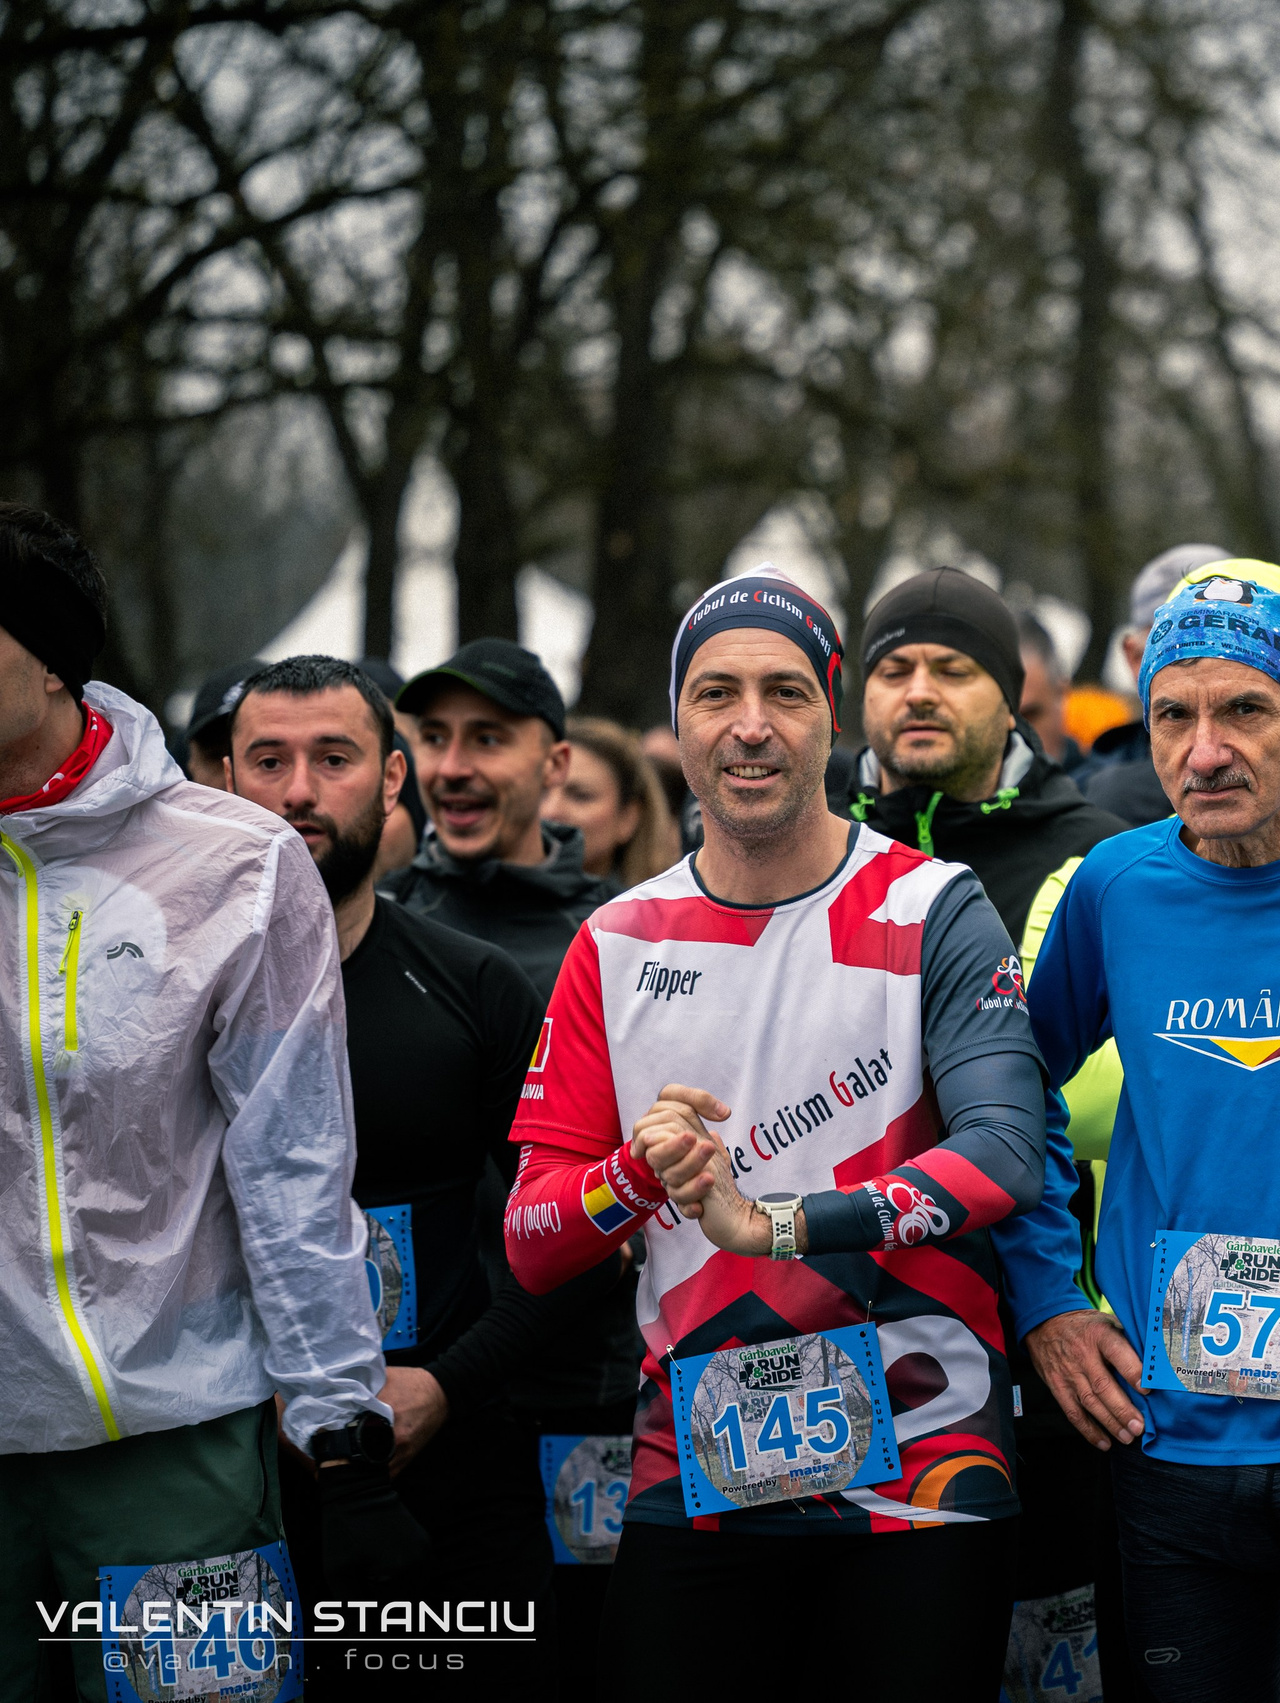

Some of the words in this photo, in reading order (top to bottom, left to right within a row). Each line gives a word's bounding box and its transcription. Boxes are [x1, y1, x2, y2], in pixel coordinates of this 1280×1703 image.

[688, 594, 726, 630] Clubul
[730, 591, 748, 604] de
[754, 590, 803, 620] Ciclism
[636, 961, 702, 1001] Flipper
[1004, 996, 1013, 1007] de
[750, 1093, 834, 1160] Ciclism
[872, 1196, 886, 1208] de
[878, 1210, 894, 1240] Ciclism
[1235, 1259, 1246, 1270] &
[1243, 1269, 1280, 1282] RIDE
[739, 1343, 797, 1362] Gârboavele
[753, 1366, 764, 1378] &
[758, 1354, 800, 1372] RUN
[760, 1367, 802, 1386] RIDE
[1176, 1367, 1214, 1378] Powered
[1216, 1370, 1228, 1380] by
[1240, 1368, 1278, 1378] maus
[712, 1385, 851, 1471] 145
[722, 1480, 763, 1494] Powered
[765, 1478, 778, 1488] by
[790, 1464, 830, 1478] maus
[178, 1561, 236, 1577] Gârboavele
[198, 1570, 238, 1589] RUN
[192, 1584, 202, 1595] &
[199, 1584, 240, 1602] RIDE
[142, 1604, 276, 1686] 146
[1041, 1633, 1098, 1695] 4
[220, 1682, 258, 1695] maus
